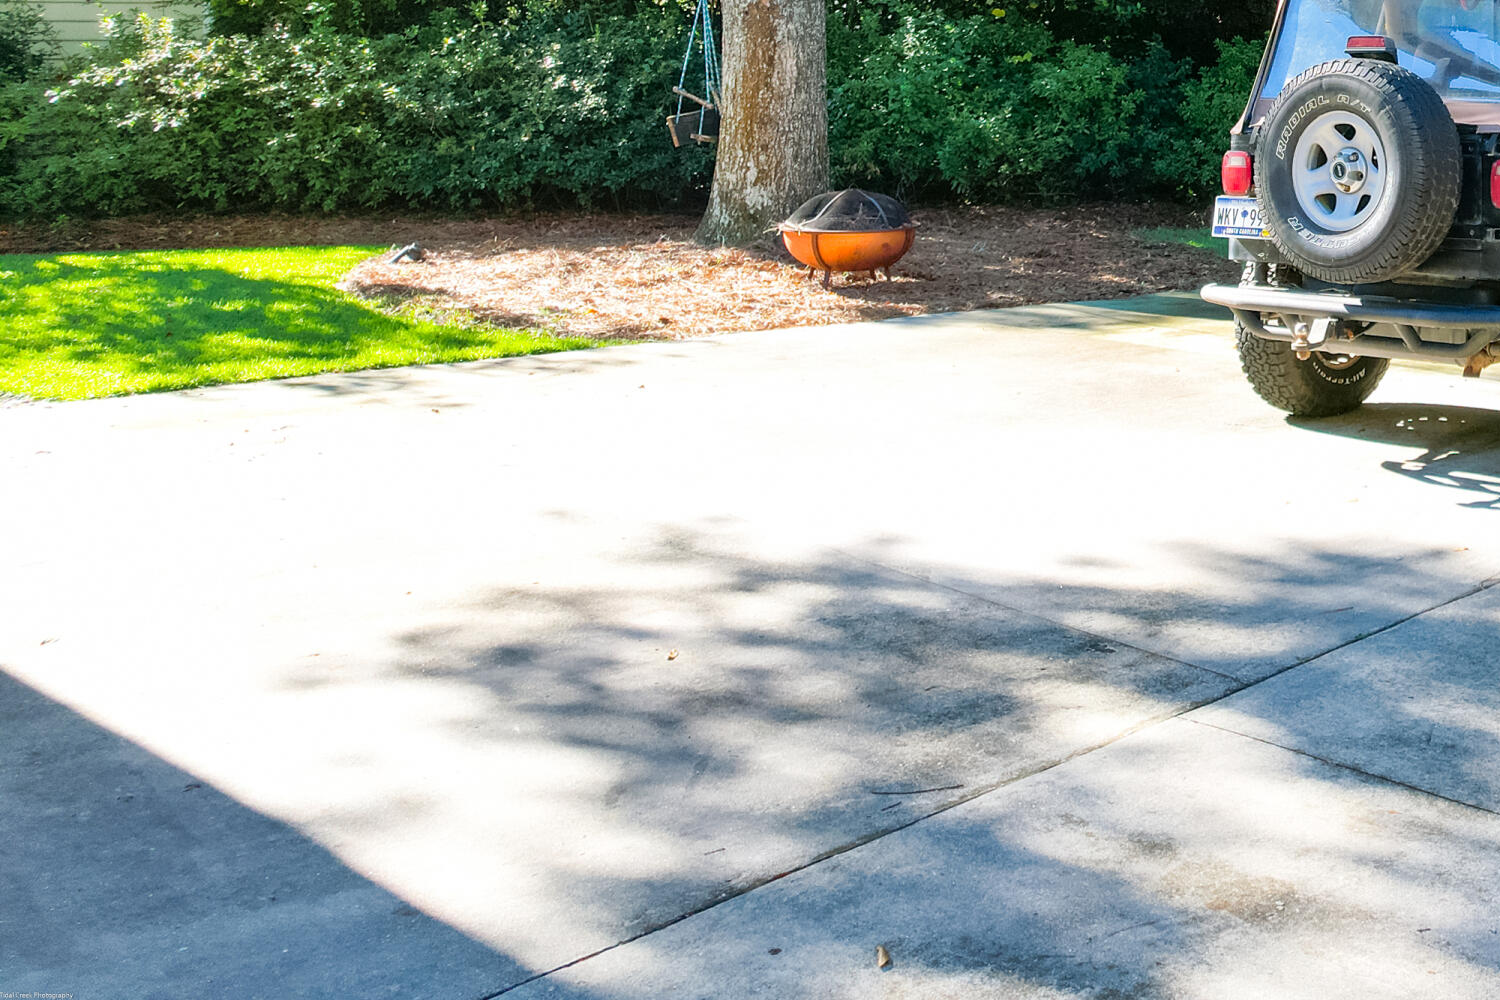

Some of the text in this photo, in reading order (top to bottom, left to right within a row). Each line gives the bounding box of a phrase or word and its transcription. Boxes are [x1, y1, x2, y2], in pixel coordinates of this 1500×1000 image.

[1276, 94, 1372, 160] RADIAL A/T
[1217, 207, 1239, 226] WKV
